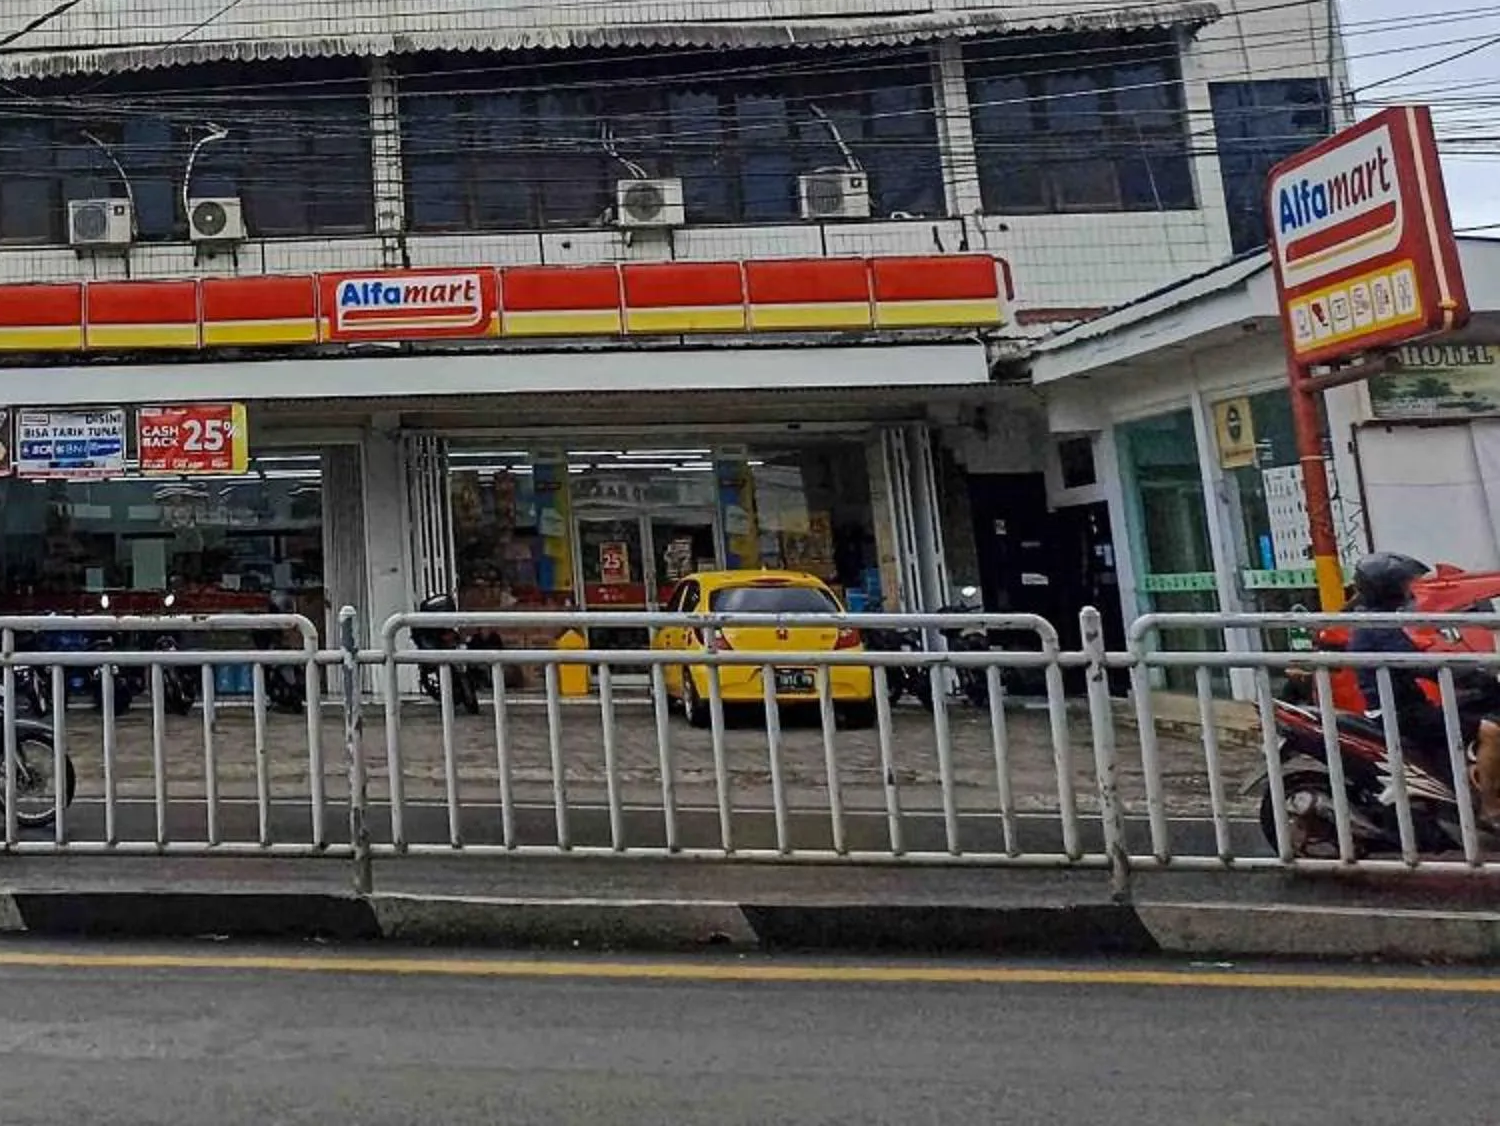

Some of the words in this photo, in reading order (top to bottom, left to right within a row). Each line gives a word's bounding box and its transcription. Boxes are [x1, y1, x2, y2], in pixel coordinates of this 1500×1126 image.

[1279, 146, 1391, 234] Alfamart
[341, 279, 477, 306] Alfamart
[1401, 344, 1494, 367] HOTEL
[23, 427, 49, 438] BISA
[52, 427, 84, 437] TARIK
[141, 425, 180, 437] CASH
[141, 437, 180, 447] BACK
[181, 419, 238, 451] 25%
